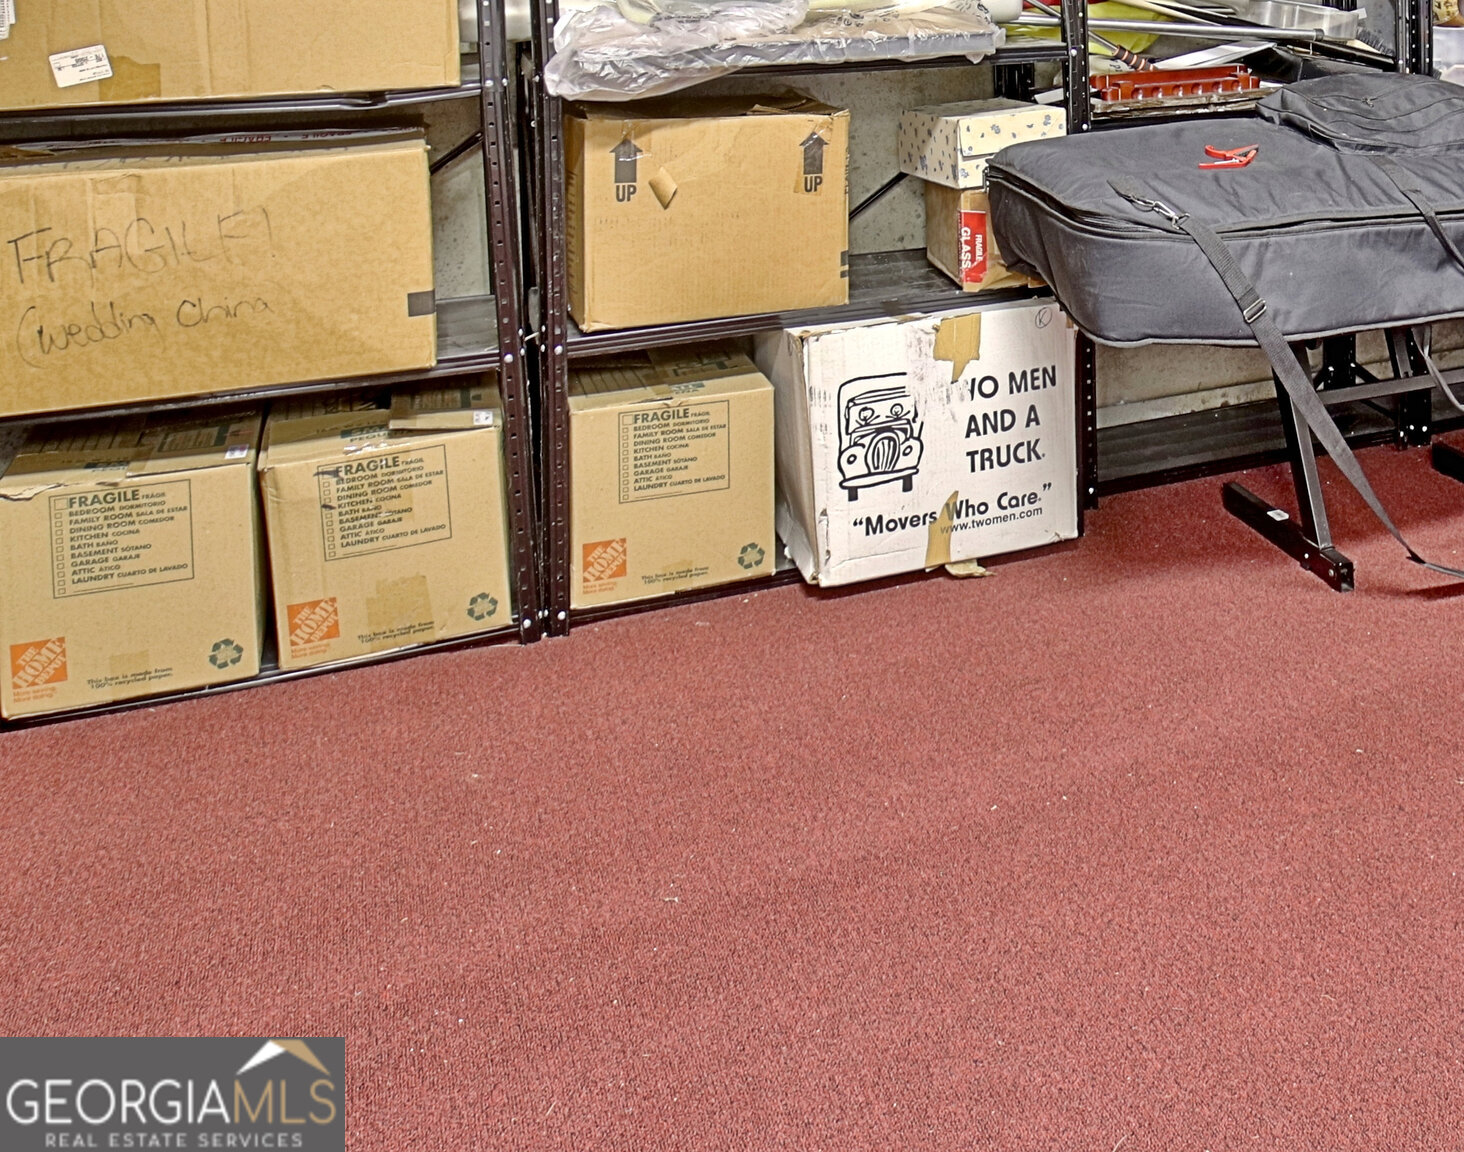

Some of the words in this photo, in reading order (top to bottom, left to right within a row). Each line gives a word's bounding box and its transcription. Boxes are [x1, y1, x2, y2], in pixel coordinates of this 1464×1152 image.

[804, 175, 823, 193] UP
[615, 184, 637, 202] UP
[961, 227, 971, 268] GLASS
[1008, 365, 1056, 394] MEN
[634, 408, 689, 424] FRAGILE
[965, 408, 1016, 439] AND
[1025, 404, 1040, 428] A
[633, 423, 670, 431] BEDROOM
[634, 446, 664, 454] KITCHEN
[634, 460, 671, 469] BASEMENT
[634, 468, 664, 476] GARAGE
[337, 483, 365, 493] FAMILY
[368, 479, 394, 487] ROOM
[634, 476, 652, 484] ATTIC
[634, 482, 667, 491] LAUNDRY
[69, 490, 140, 508] FRAGILE
[337, 491, 368, 501] DINING
[371, 486, 397, 495] ROOM
[376, 494, 401, 503] COCINA
[69, 506, 115, 517] BEDROOM
[119, 500, 166, 511] DORMITORIO
[338, 508, 360, 517] BATH
[945, 499, 989, 520] Who
[69, 516, 103, 525] FAMILY
[104, 512, 133, 521] ROOM
[70, 524, 103, 534] DINING
[107, 520, 136, 528] ROOM
[139, 516, 174, 525] COMEDOR
[940, 506, 1043, 534] www.twomen.com
[340, 522, 374, 532] GARAGE
[70, 532, 108, 542] KITCHEN
[112, 529, 140, 537] COCINA
[340, 531, 362, 540] ATTIC
[341, 536, 380, 548] LAUNDRY
[381, 531, 408, 541] CUARTO
[420, 524, 446, 533] LAVADO
[70, 542, 94, 551] BATH
[70, 548, 118, 559] BASEMENT
[71, 558, 109, 567] GARAGE
[72, 567, 95, 576] ATTIC
[72, 574, 114, 584] LAUNDRY
[117, 569, 146, 578] CUARTO
[160, 563, 188, 572] LAVADO
